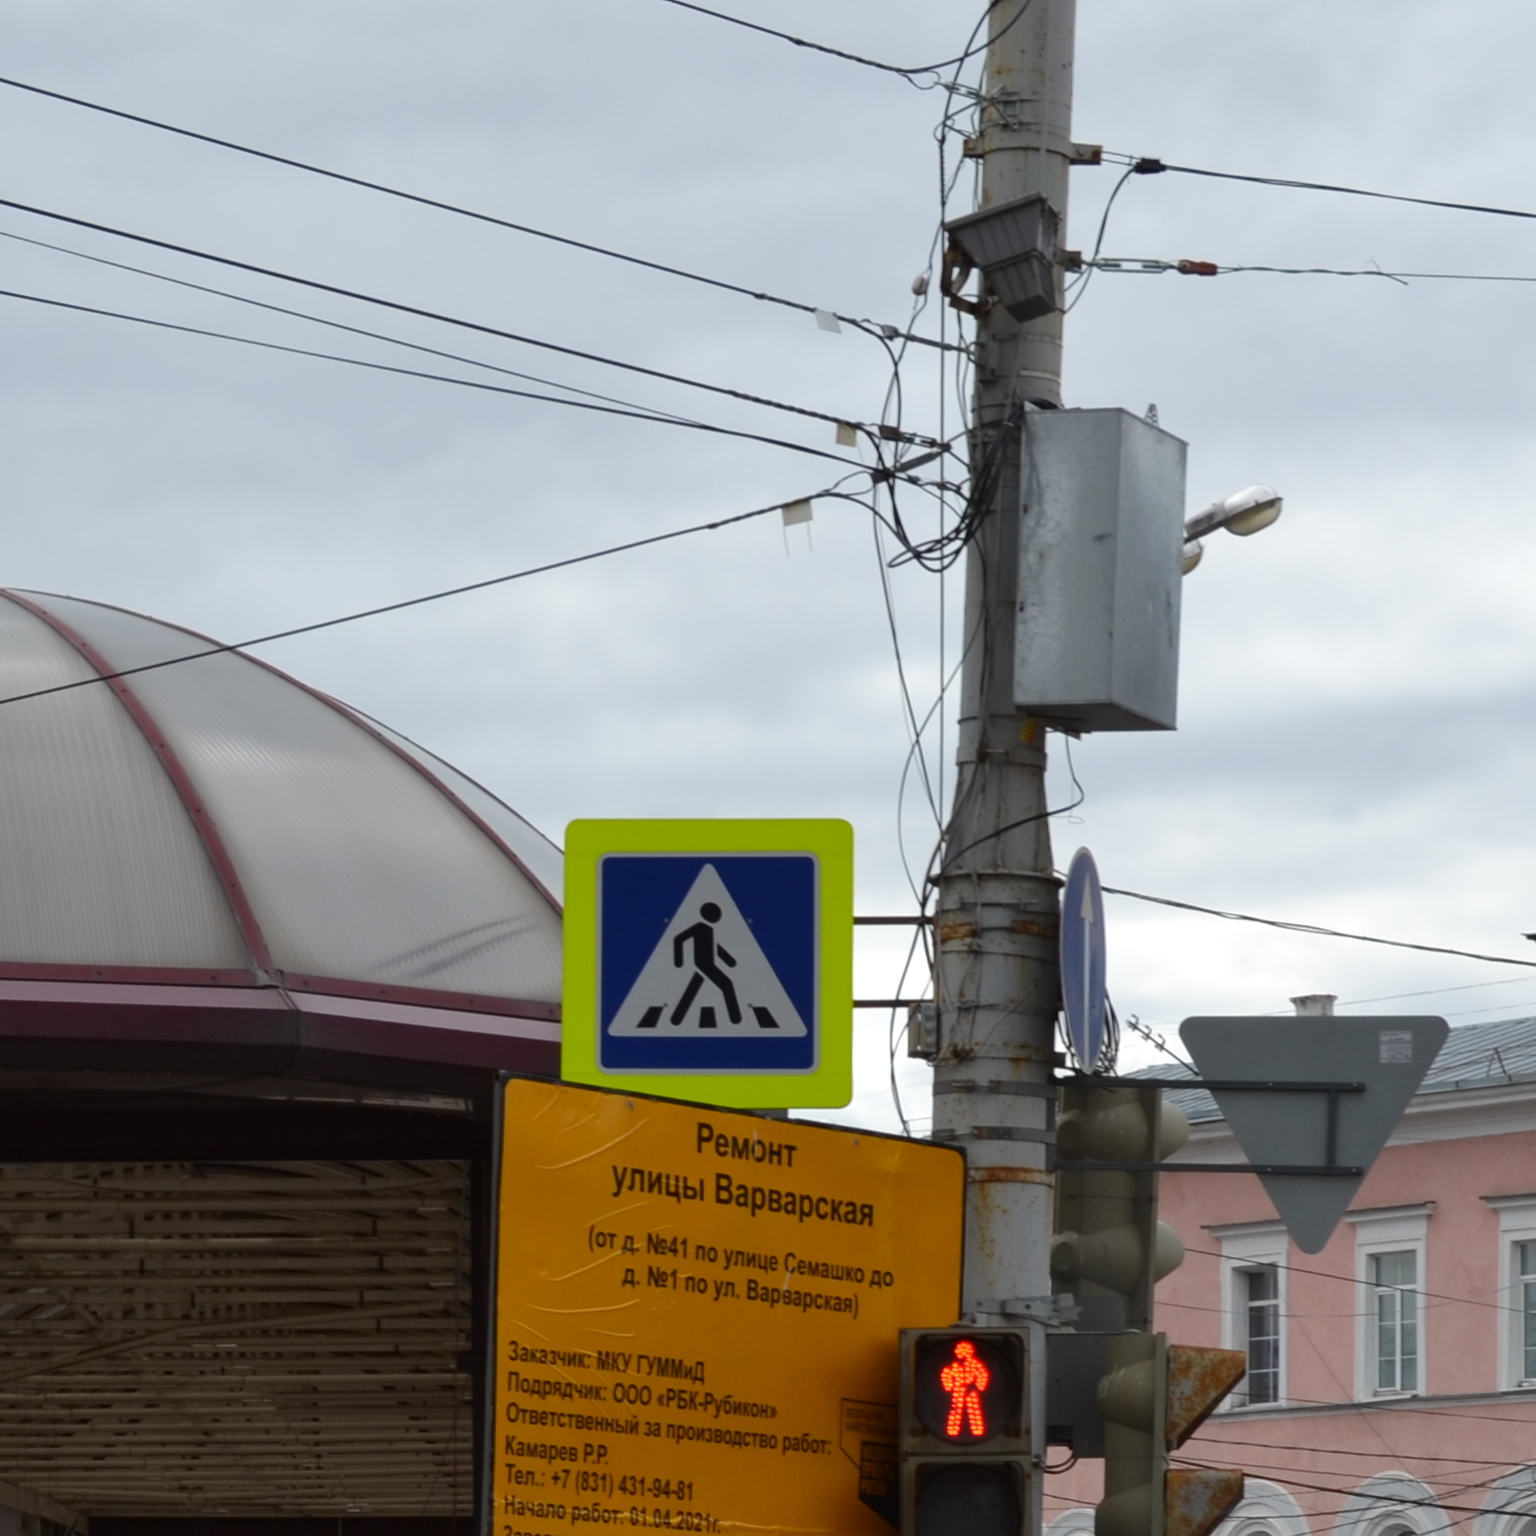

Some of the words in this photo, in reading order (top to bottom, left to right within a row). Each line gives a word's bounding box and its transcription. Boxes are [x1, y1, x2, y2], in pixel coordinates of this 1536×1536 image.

[697, 1122, 797, 1167] Ремонт
[612, 1165, 704, 1203] улицы
[715, 1173, 874, 1227] Варварская
[589, 1225, 615, 1252] (от
[622, 1235, 640, 1256] д.
[647, 1233, 688, 1259] №41
[695, 1244, 718, 1263] по
[724, 1249, 778, 1274] улице
[785, 1252, 864, 1283] Семашко
[869, 1269, 894, 1289] до
[622, 1268, 640, 1288] д.
[647, 1266, 677, 1289] №1
[686, 1274, 708, 1294] по
[713, 1280, 740, 1301] ул.
[747, 1279, 859, 1319] Варварская)
[508, 1341, 591, 1369] Заказчик:
[597, 1350, 632, 1374] МКУ
[637, 1355, 705, 1386] ГУММиД
[507, 1371, 607, 1401] Подрядчик:
[613, 1382, 652, 1406] ООО
[657, 1388, 777, 1419] «РБК-Рубикон»
[505, 1435, 578, 1465] Камарев
[583, 1443, 609, 1465] Р.Р.
[506, 1402, 639, 1435] Ответственный
[643, 1421, 661, 1437] за
[667, 1423, 779, 1449] производство
[782, 1433, 832, 1455] работ:
[505, 1463, 545, 1487] Тел.:
[551, 1469, 570, 1489] +7
[575, 1470, 614, 1498] (831)
[618, 1474, 693, 1500] 431-94-81
[504, 1494, 566, 1520] Начало
[571, 1502, 624, 1525] работ:
